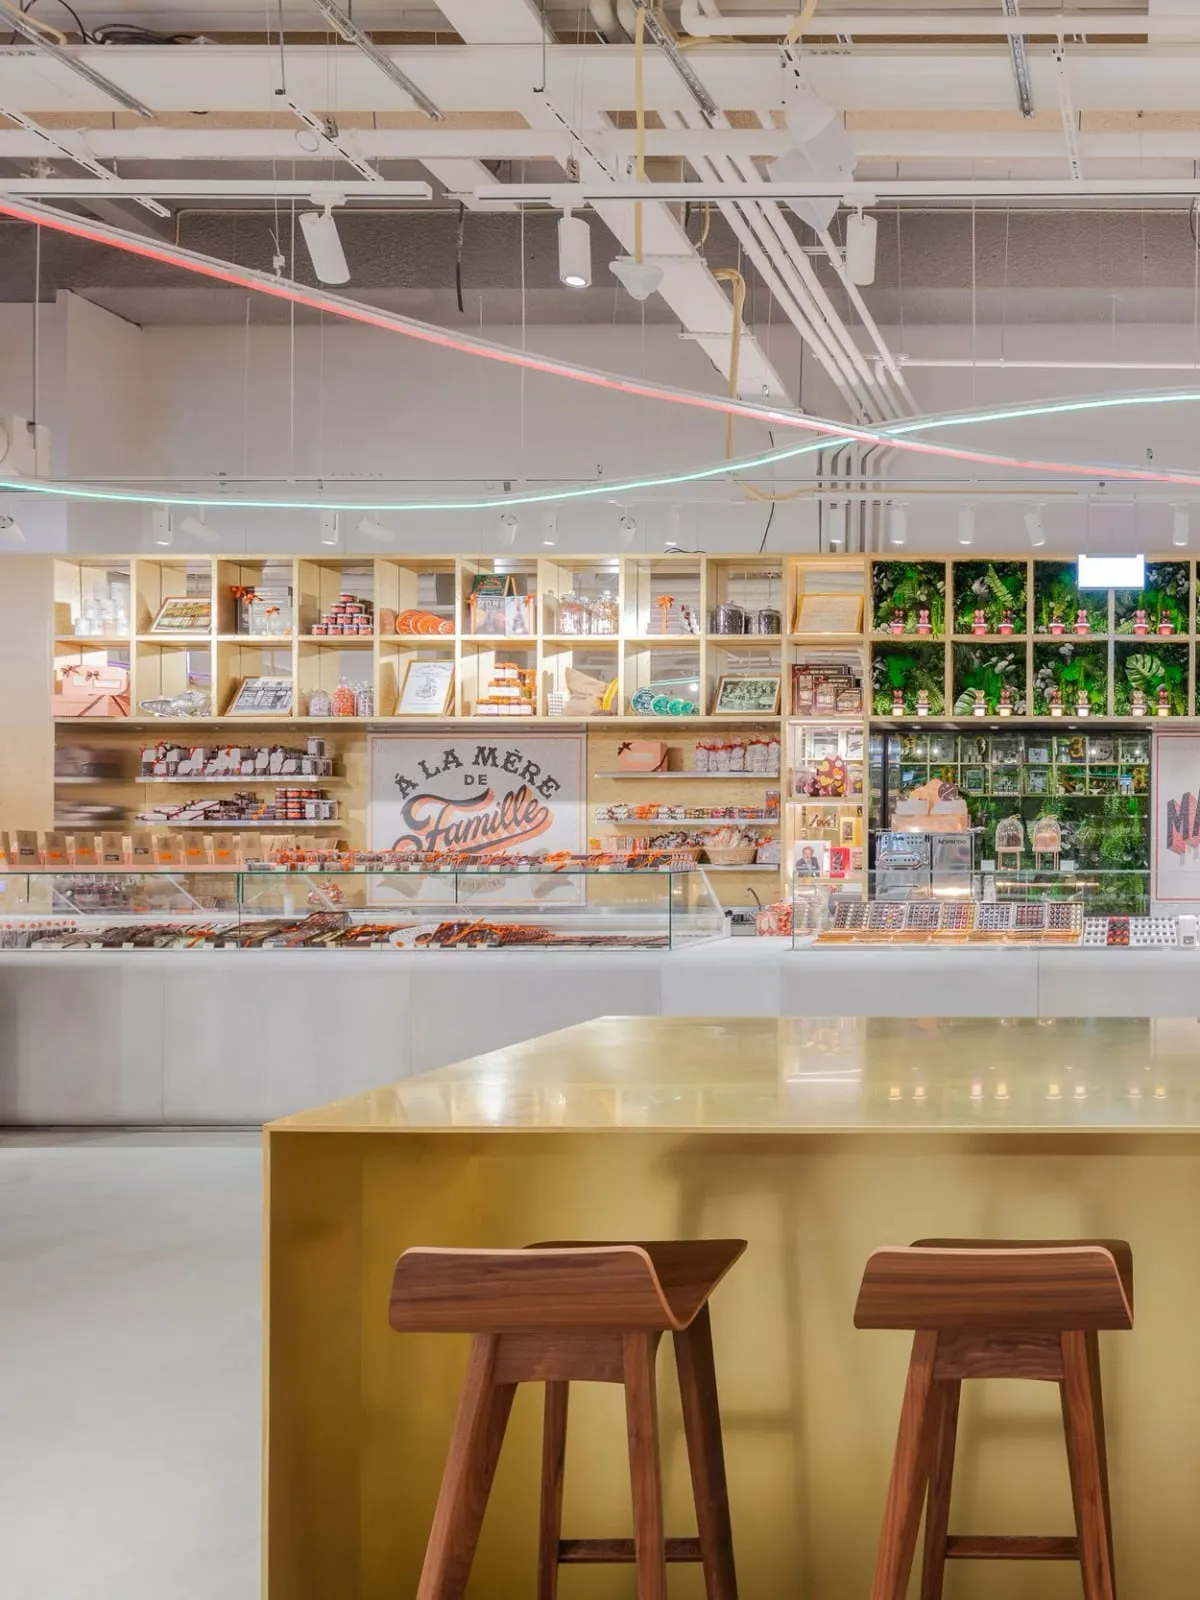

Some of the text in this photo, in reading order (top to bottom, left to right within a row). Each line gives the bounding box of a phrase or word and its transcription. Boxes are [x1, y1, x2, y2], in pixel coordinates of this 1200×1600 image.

[394, 745, 561, 799] À LA MÈRE
[464, 774, 488, 786] DE
[392, 784, 555, 852] Famille
